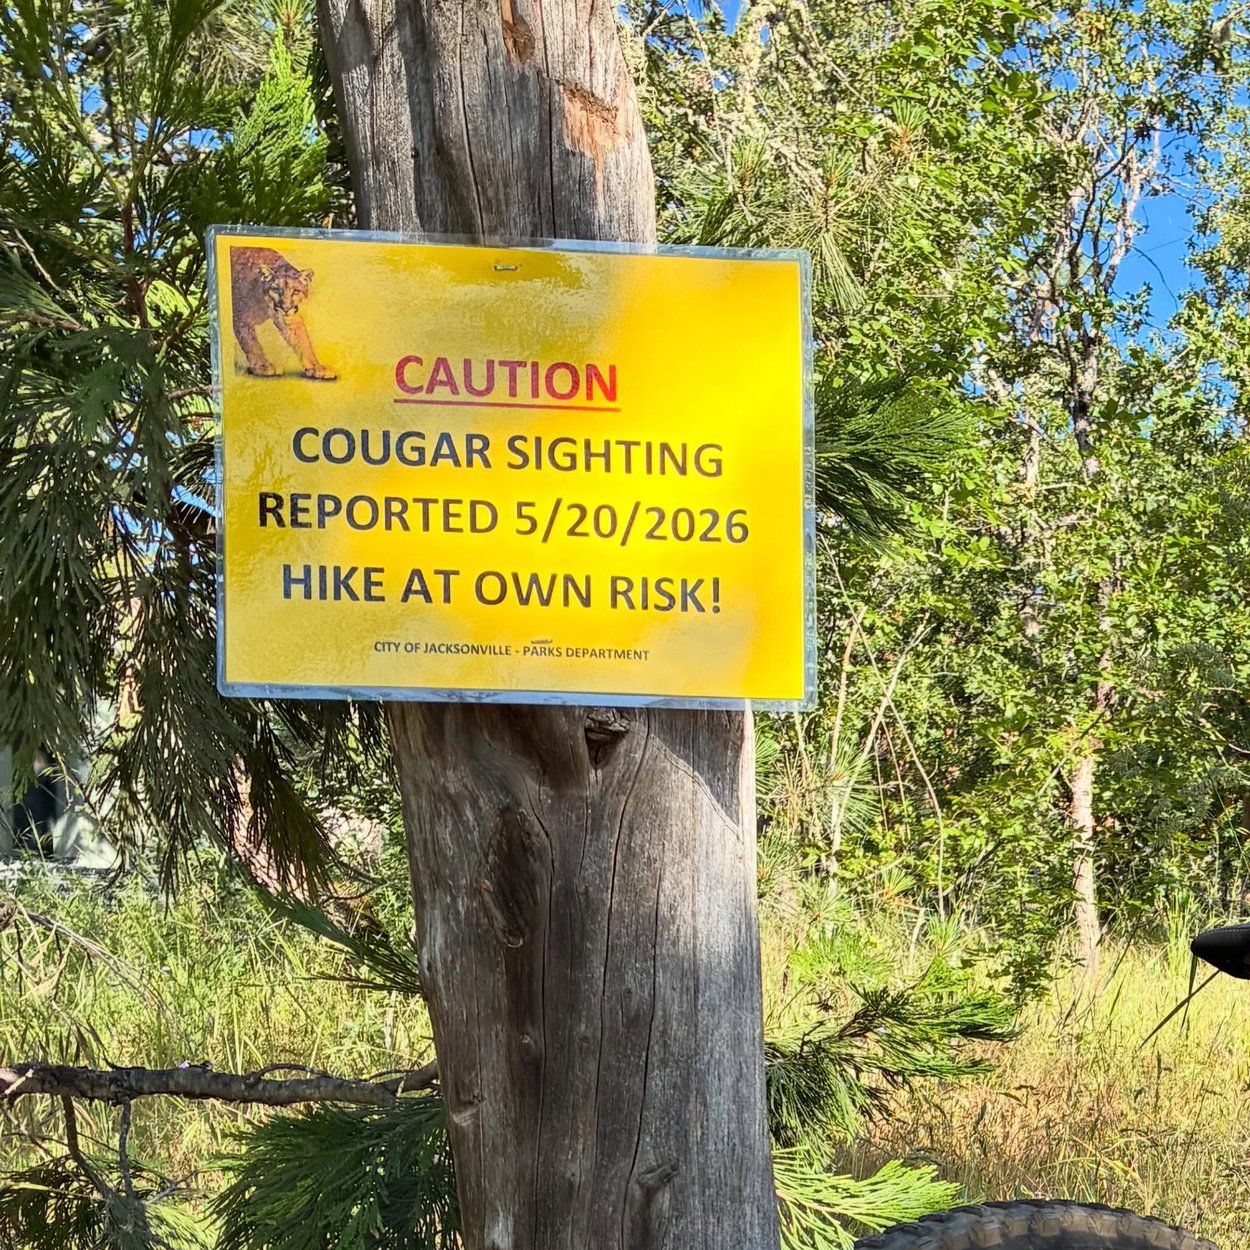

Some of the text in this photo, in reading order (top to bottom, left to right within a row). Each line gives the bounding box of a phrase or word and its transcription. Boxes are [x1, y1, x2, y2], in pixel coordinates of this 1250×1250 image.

[395, 355, 617, 402] CAUTION
[292, 426, 723, 478] COUGAR SIGHTING
[258, 491, 749, 547] REPORTED 5/20/2026
[282, 563, 721, 614] HIKE AT OWN RISK!
[373, 641, 401, 654] CITY
[403, 642, 421, 654] OF
[423, 642, 512, 656] JACKSONVILLE
[523, 645, 563, 659] PARKS
[565, 647, 650, 661] DEPARTMENT
